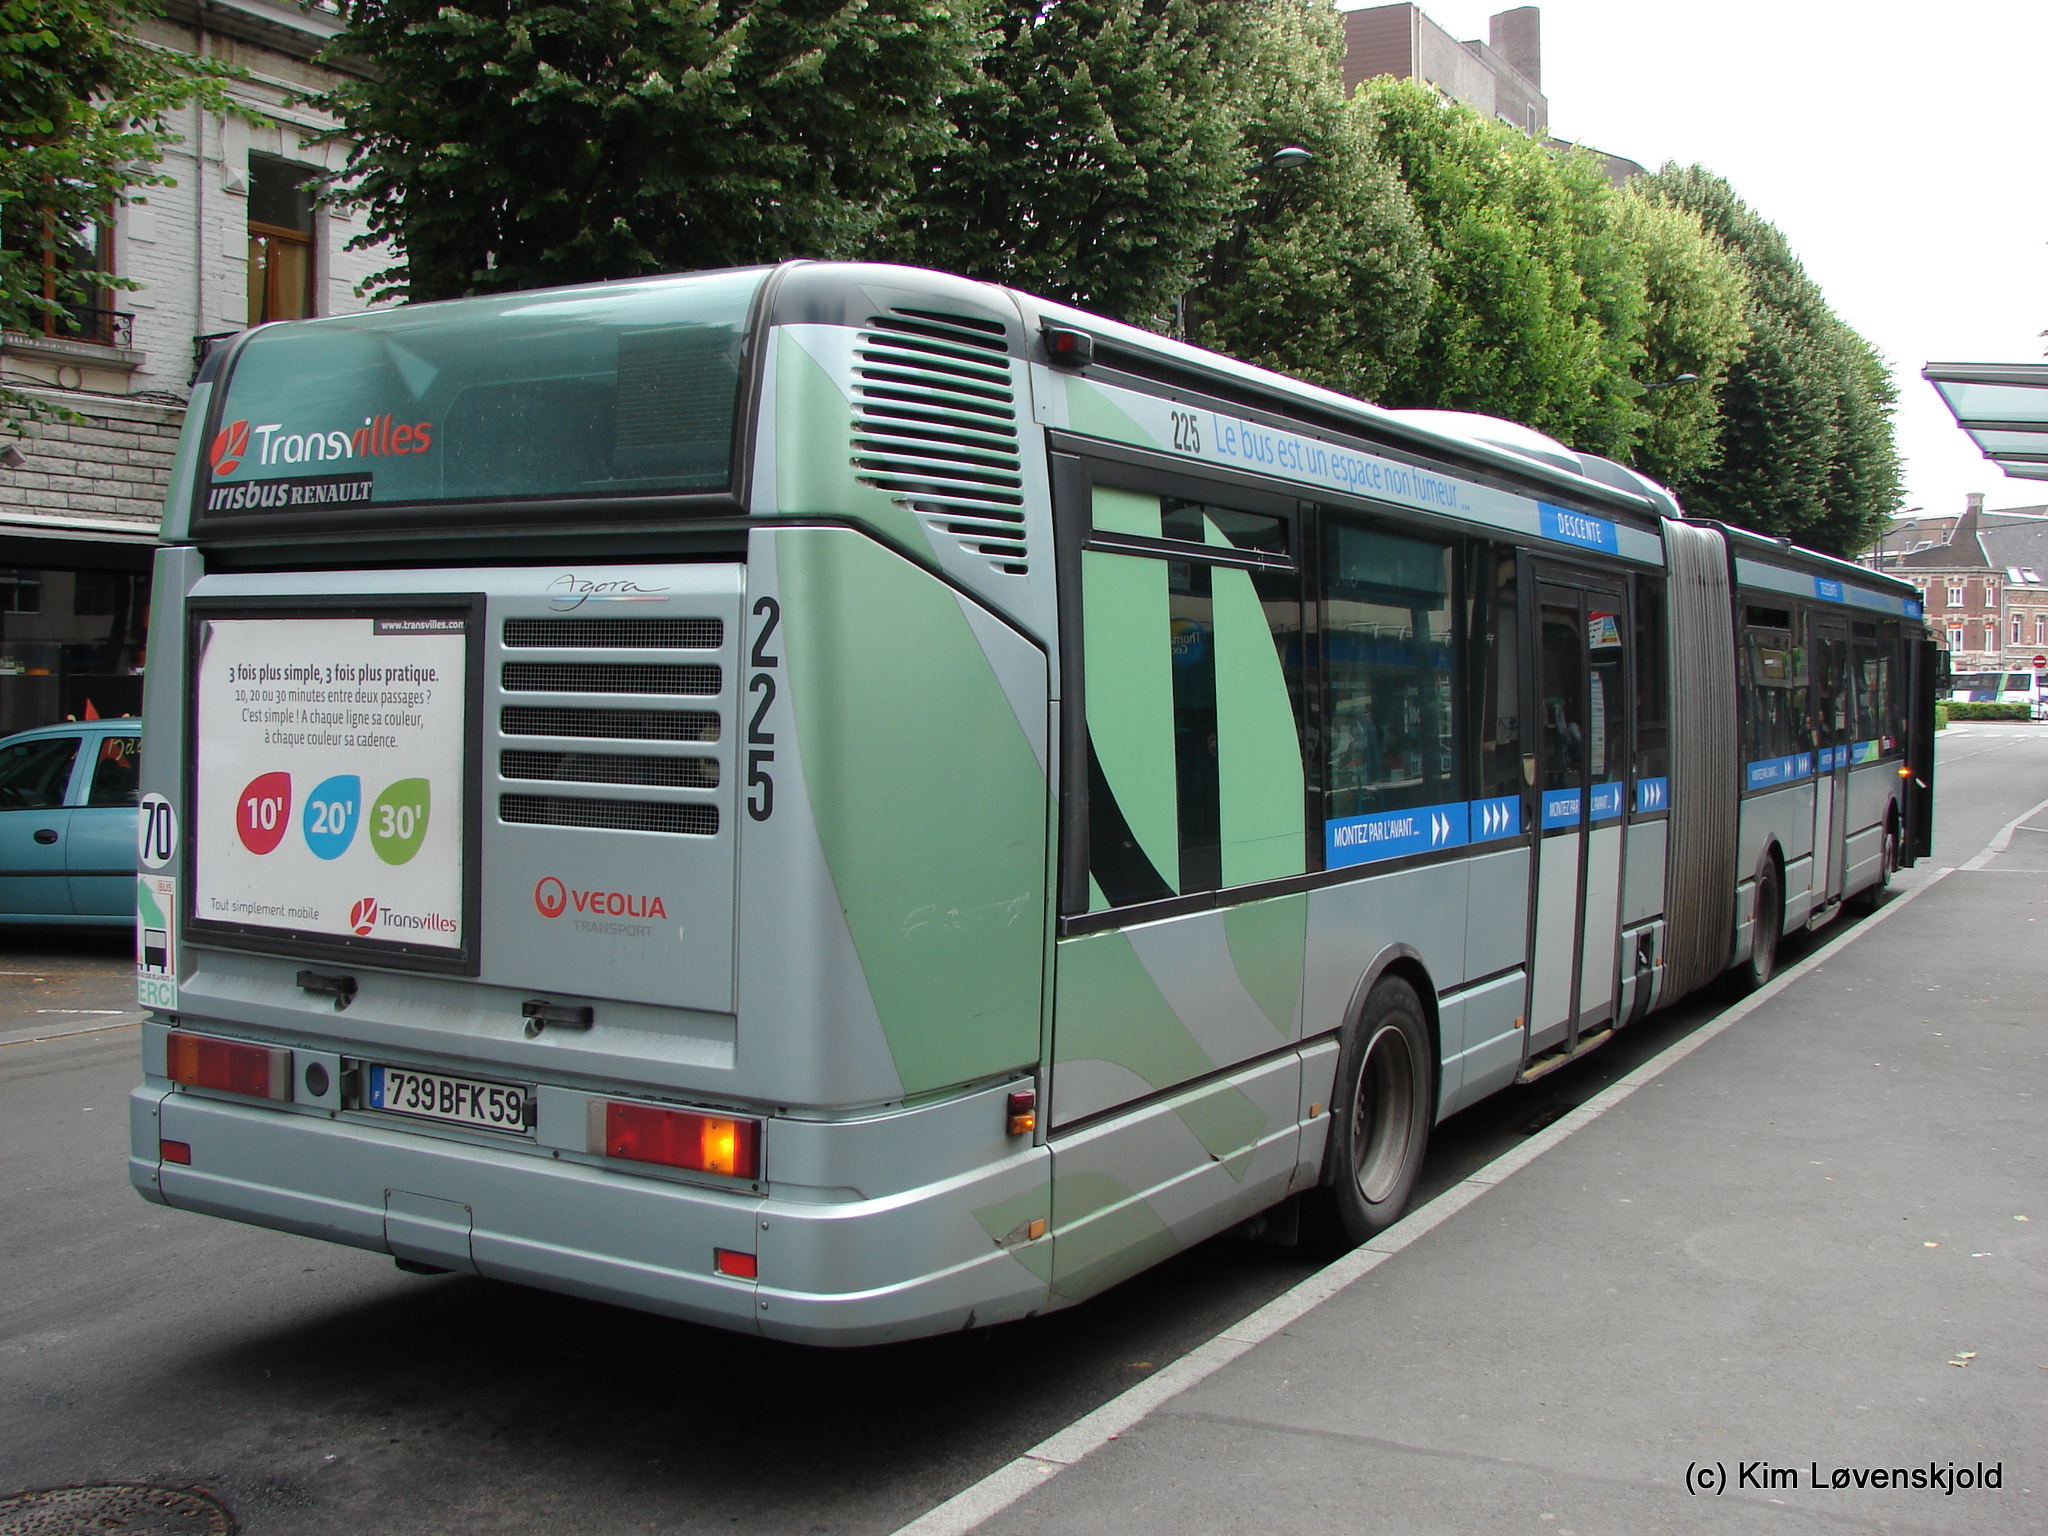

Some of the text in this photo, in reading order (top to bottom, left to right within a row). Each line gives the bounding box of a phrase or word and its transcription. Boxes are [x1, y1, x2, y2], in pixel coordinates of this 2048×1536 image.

[254, 413, 432, 465] Transvilles
[1171, 410, 1201, 454] 225
[1213, 413, 1236, 456] Le
[1240, 419, 1274, 465] bus
[1278, 437, 1303, 472] est
[1305, 446, 1328, 477] un
[1331, 453, 1382, 492] espace
[1384, 467, 1411, 496] non
[1412, 466, 1457, 508] fumeur
[290, 481, 373, 505] RENAULT
[1558, 512, 1603, 544] DESCENTE
[545, 573, 671, 612] Agora
[229, 663, 439, 687] 3 fois plus simple, 3 fois plus pratique.
[235, 690, 248, 704] 10,
[250, 690, 260, 702] 20
[262, 690, 274, 702] ou
[276, 690, 286, 704] 30
[289, 687, 325, 702] minutes
[328, 689, 353, 703] entre
[355, 687, 378, 703] deux
[381, 691, 424, 708] passages
[242, 708, 262, 722] C'est
[264, 708, 294, 726] simple
[301, 709, 308, 723] A
[310, 708, 344, 728] chaque
[346, 709, 369, 729] ligne
[372, 713, 382, 725] sa
[384, 710, 424, 729] couleur,
[264, 728, 398, 748] à chaque couleur sa cadence.
[247, 796, 283, 830] 10'
[311, 800, 353, 835] 20'
[379, 804, 422, 840] 30'
[142, 801, 172, 860] 70
[1334, 823, 1368, 848] MONTEZ
[1369, 821, 1383, 842] PAR
[158, 882, 173, 893] BUS
[211, 897, 320, 920] Tout simplement mobile
[571, 889, 667, 920] VEOLIA
[379, 907, 457, 933] Transvilles
[573, 920, 653, 938] TRANSPORT
